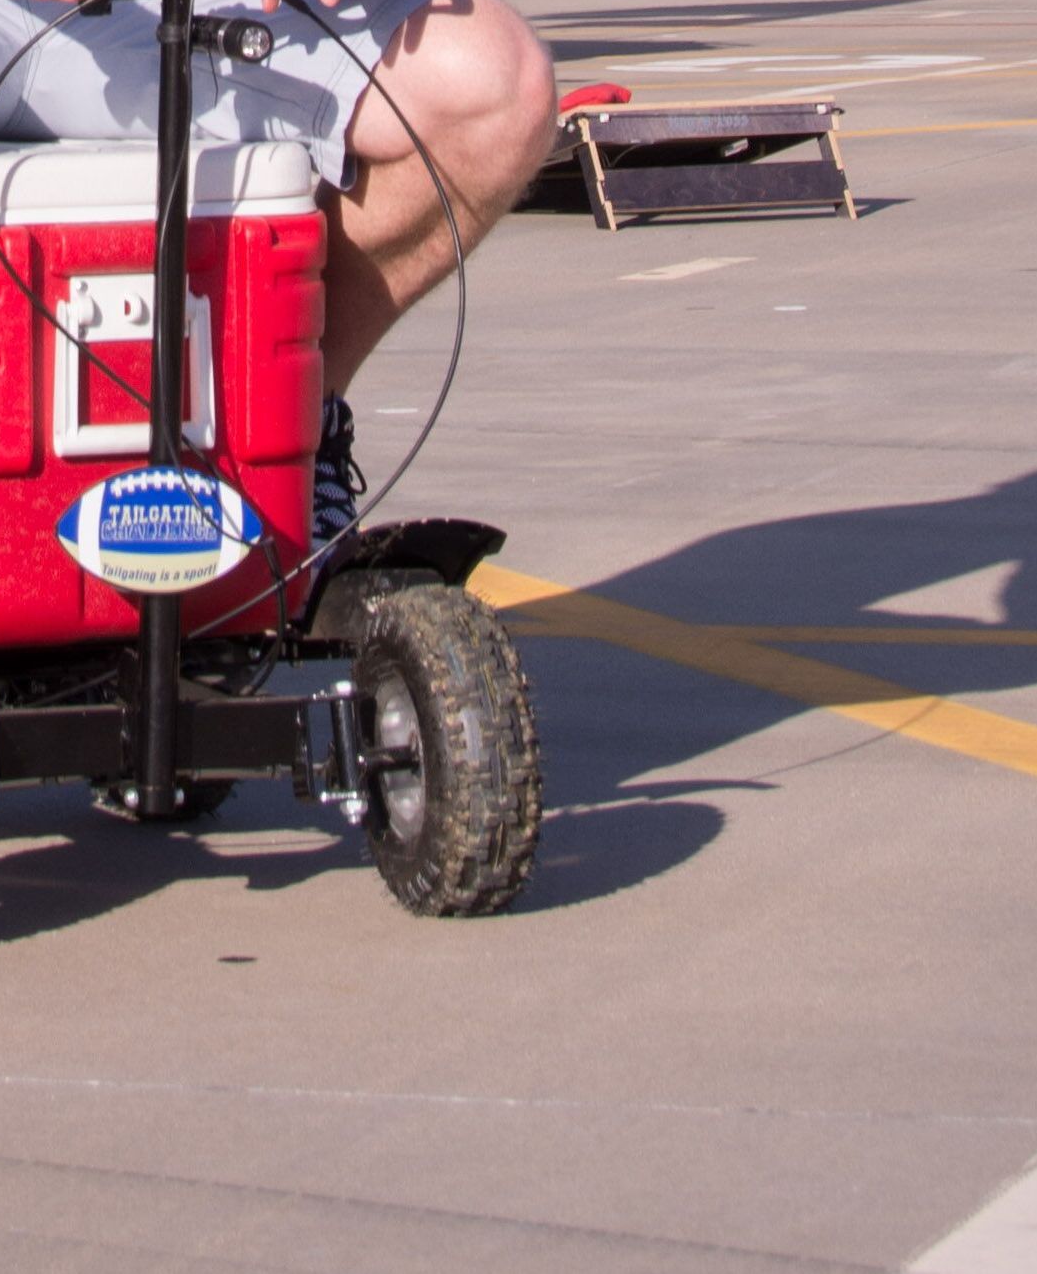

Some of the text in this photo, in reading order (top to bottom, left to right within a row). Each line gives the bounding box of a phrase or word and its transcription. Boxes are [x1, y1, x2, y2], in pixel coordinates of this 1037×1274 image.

[103, 563, 218, 584] Tailgating is a sport!
